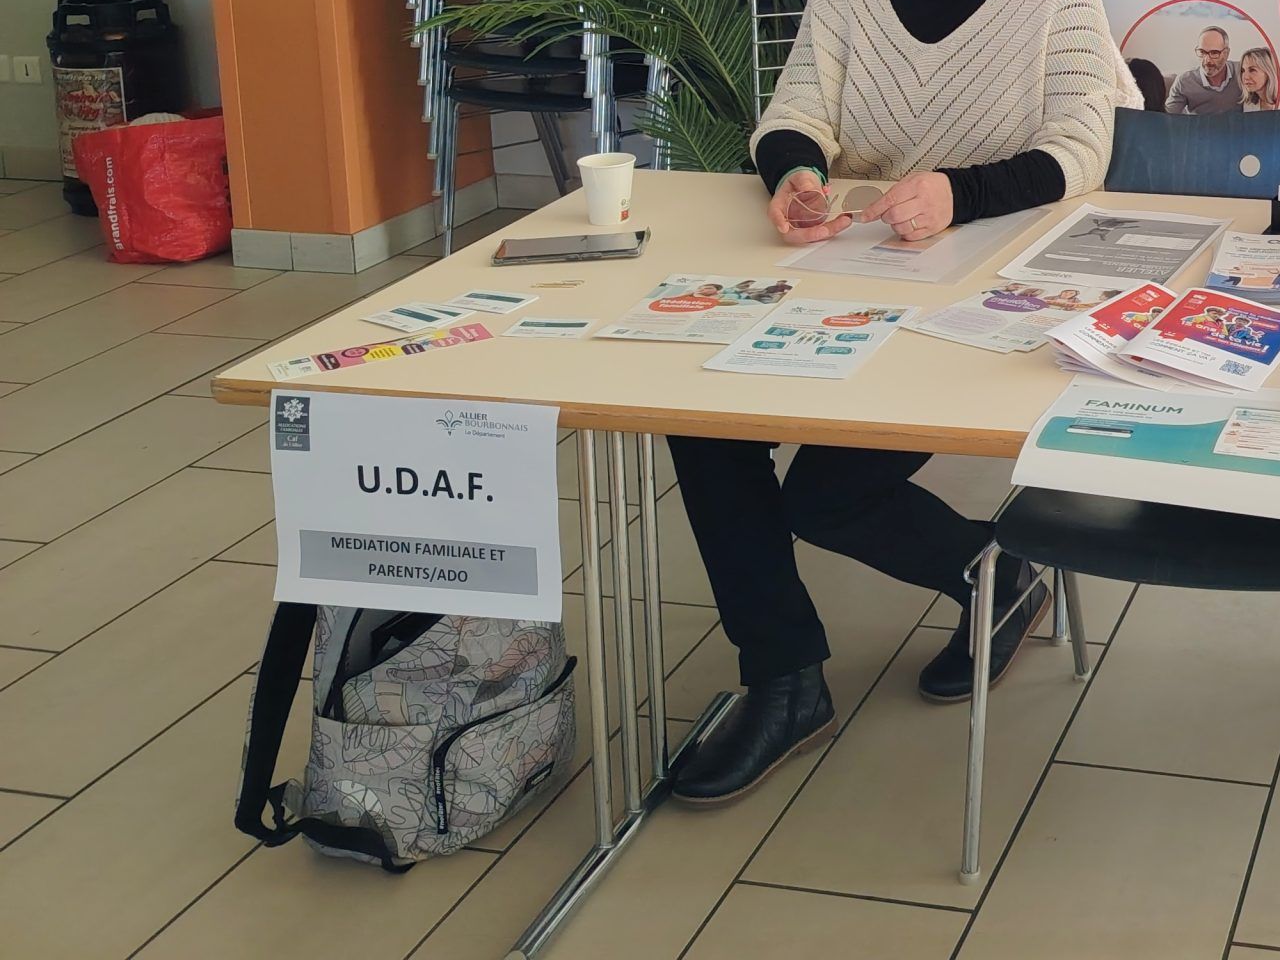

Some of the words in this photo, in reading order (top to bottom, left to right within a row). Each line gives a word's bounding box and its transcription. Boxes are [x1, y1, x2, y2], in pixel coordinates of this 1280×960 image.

[459, 411, 488, 421] ALLIER
[1085, 399, 1184, 415] FAMINUM
[464, 419, 529, 432] BOURBONNAIS
[357, 464, 494, 502] U.D.A.F.
[331, 536, 411, 554] MEDIATION
[415, 542, 486, 560] FAMILIALE
[490, 549, 506, 562] ET
[368, 563, 469, 583] PARENTS/ADO
